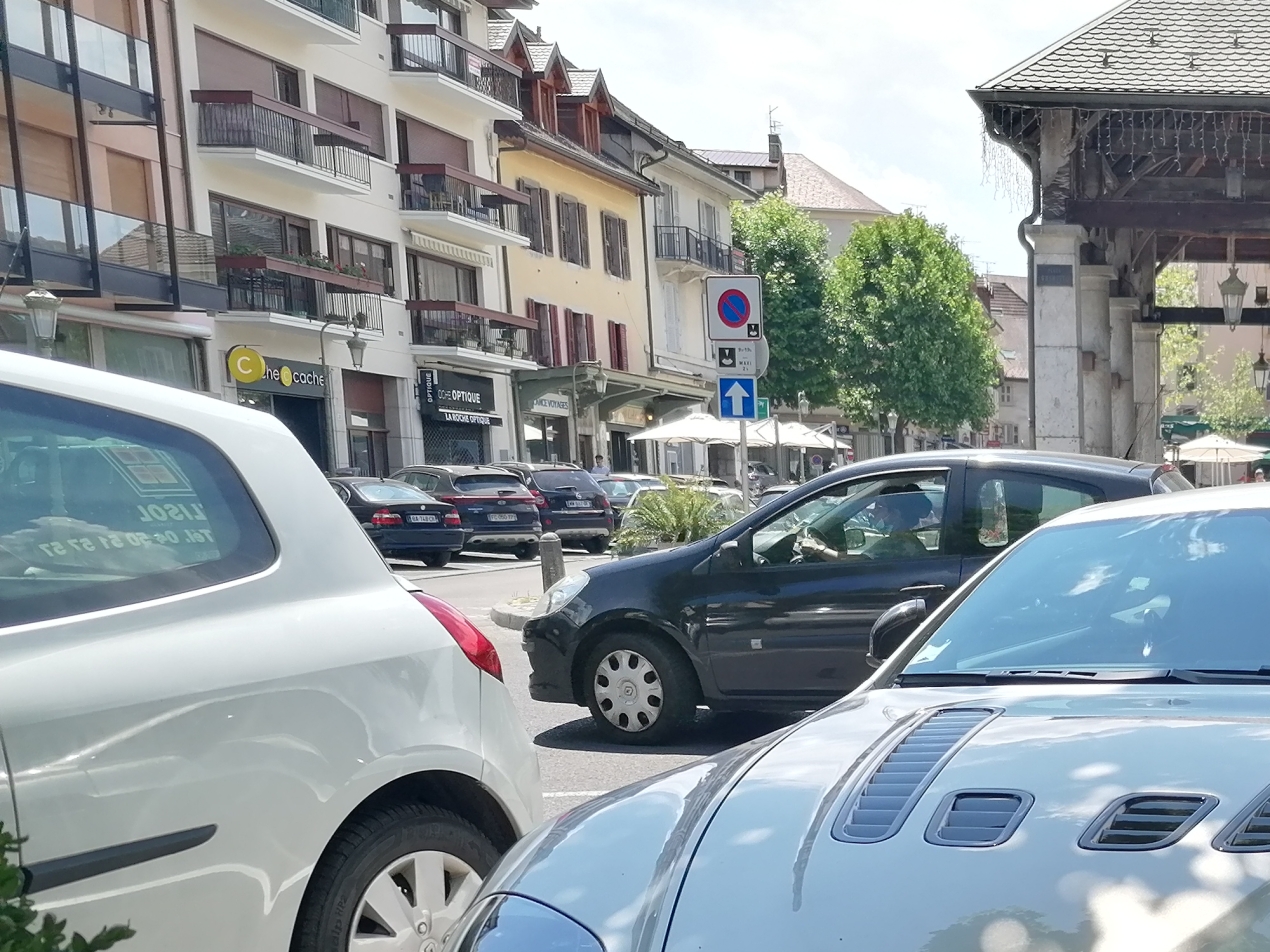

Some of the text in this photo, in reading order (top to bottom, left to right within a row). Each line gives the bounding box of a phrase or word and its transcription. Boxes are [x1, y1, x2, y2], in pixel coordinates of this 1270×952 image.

[236, 356, 253, 375] C
[293, 371, 325, 387] cache
[426, 372, 434, 403] OPTIQUE
[452, 389, 481, 404] OPTIQUE
[547, 400, 569, 410] VOYAGES
[470, 415, 491, 425] OPTIQUE
